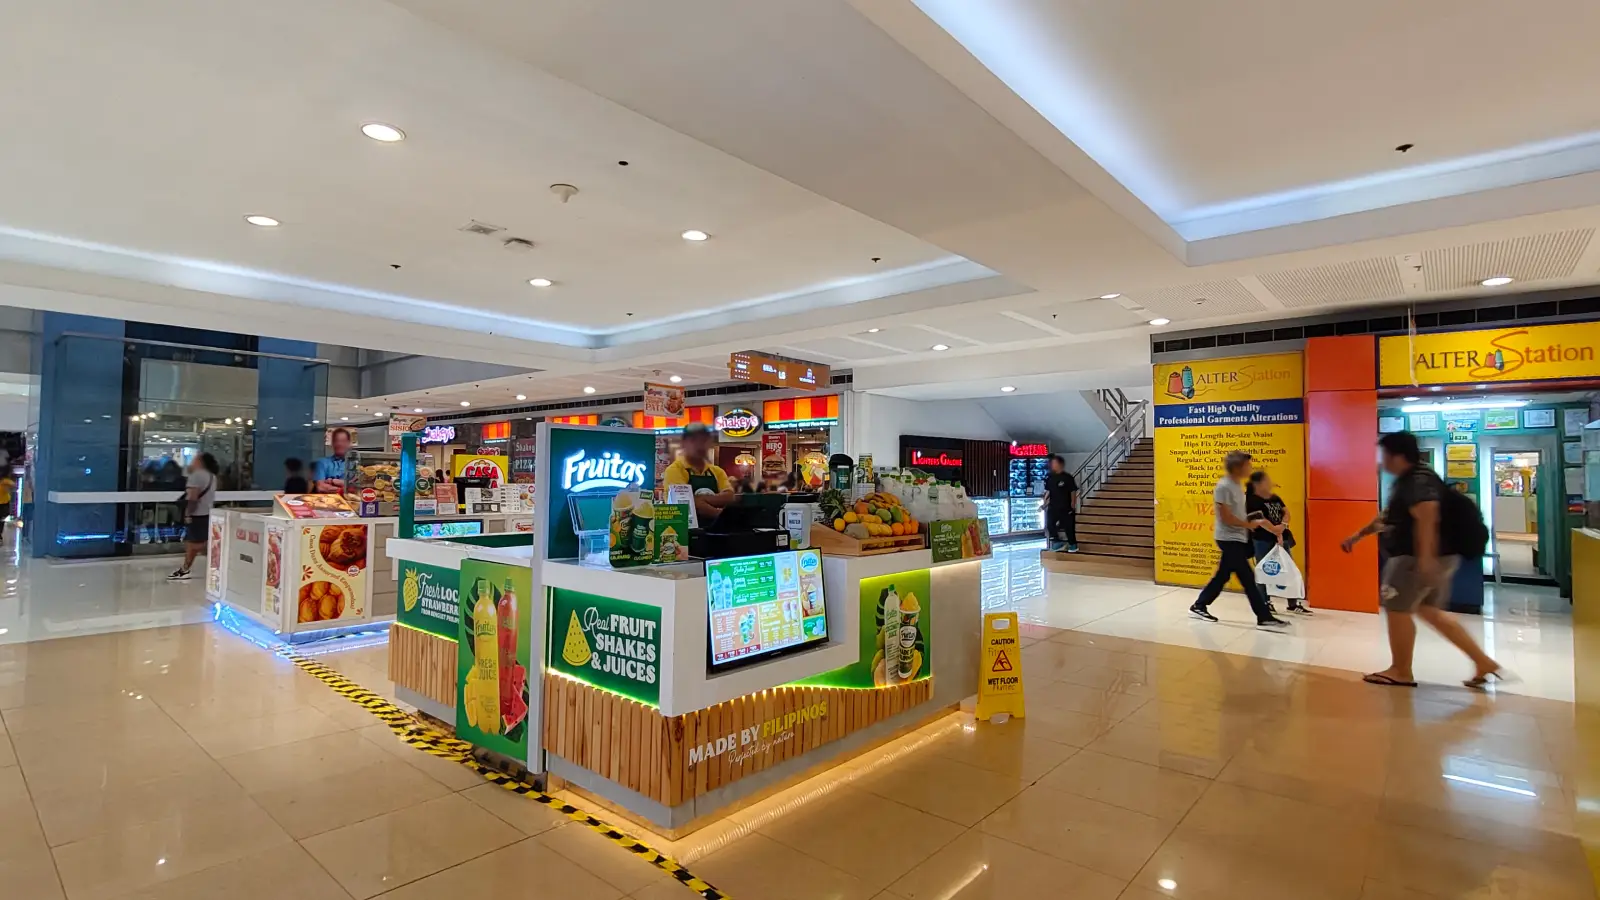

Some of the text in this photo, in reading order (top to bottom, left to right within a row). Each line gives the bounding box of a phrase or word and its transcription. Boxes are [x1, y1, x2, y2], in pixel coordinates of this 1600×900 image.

[1415, 331, 1594, 378] ALTER Station
[1196, 364, 1290, 391] ALTER Station
[1188, 403, 1261, 414] Fast High Quality
[715, 415, 759, 431] Shakey's
[1159, 412, 1298, 425] Professional Garments Alterations
[1200, 432, 1224, 440] Length
[766, 442, 783, 450] HERO
[1184, 440, 1199, 448] Hips
[912, 450, 963, 466] LIGHTERS GALORE
[1191, 448, 1211, 456] Adjust
[465, 466, 499, 479] CASA
[562, 449, 647, 490] Fruitas
[1187, 472, 1210, 480] Repair
[1171, 520, 1206, 533] your
[417, 573, 460, 604] Fresh LOC
[421, 597, 460, 616] STRAWBERR
[582, 607, 656, 640] Real FRUIT
[595, 632, 656, 663] SHAKES
[479, 668, 497, 680] JUICE
[591, 651, 656, 684] & JUICES
[988, 677, 1018, 685] WET FLOOR
[688, 700, 827, 766] MADE BY FILIPINOS
